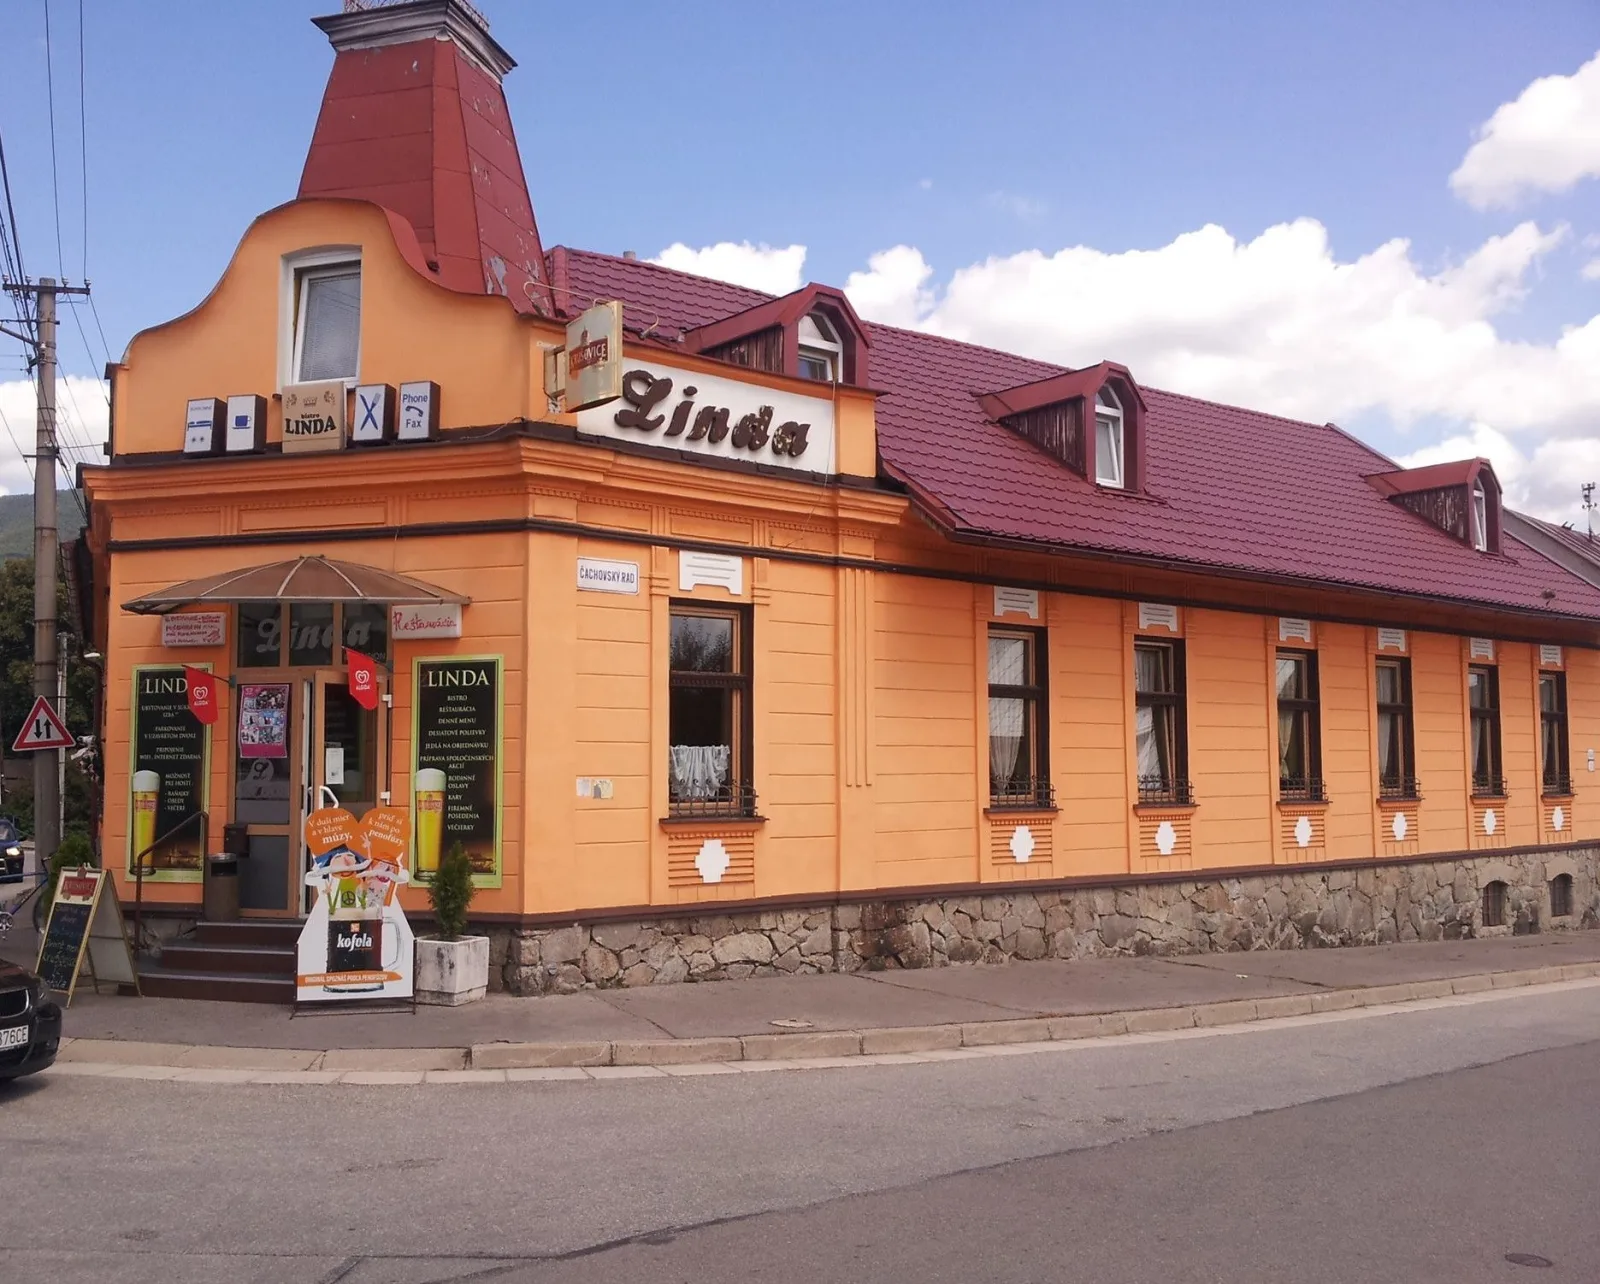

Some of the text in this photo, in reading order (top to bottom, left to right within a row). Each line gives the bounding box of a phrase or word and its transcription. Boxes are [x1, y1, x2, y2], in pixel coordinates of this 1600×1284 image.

[402, 393, 429, 404] Phone
[300, 412, 320, 420] bistro
[614, 369, 812, 458] Linda
[285, 415, 337, 435] LINDA
[405, 418, 422, 429] Fax
[621, 572, 635, 584] RAD
[427, 669, 490, 687] LINDA
[145, 678, 188, 694] LIND
[332, 814, 350, 824] mier
[323, 824, 343, 833] hlave
[336, 933, 373, 952] kofola
